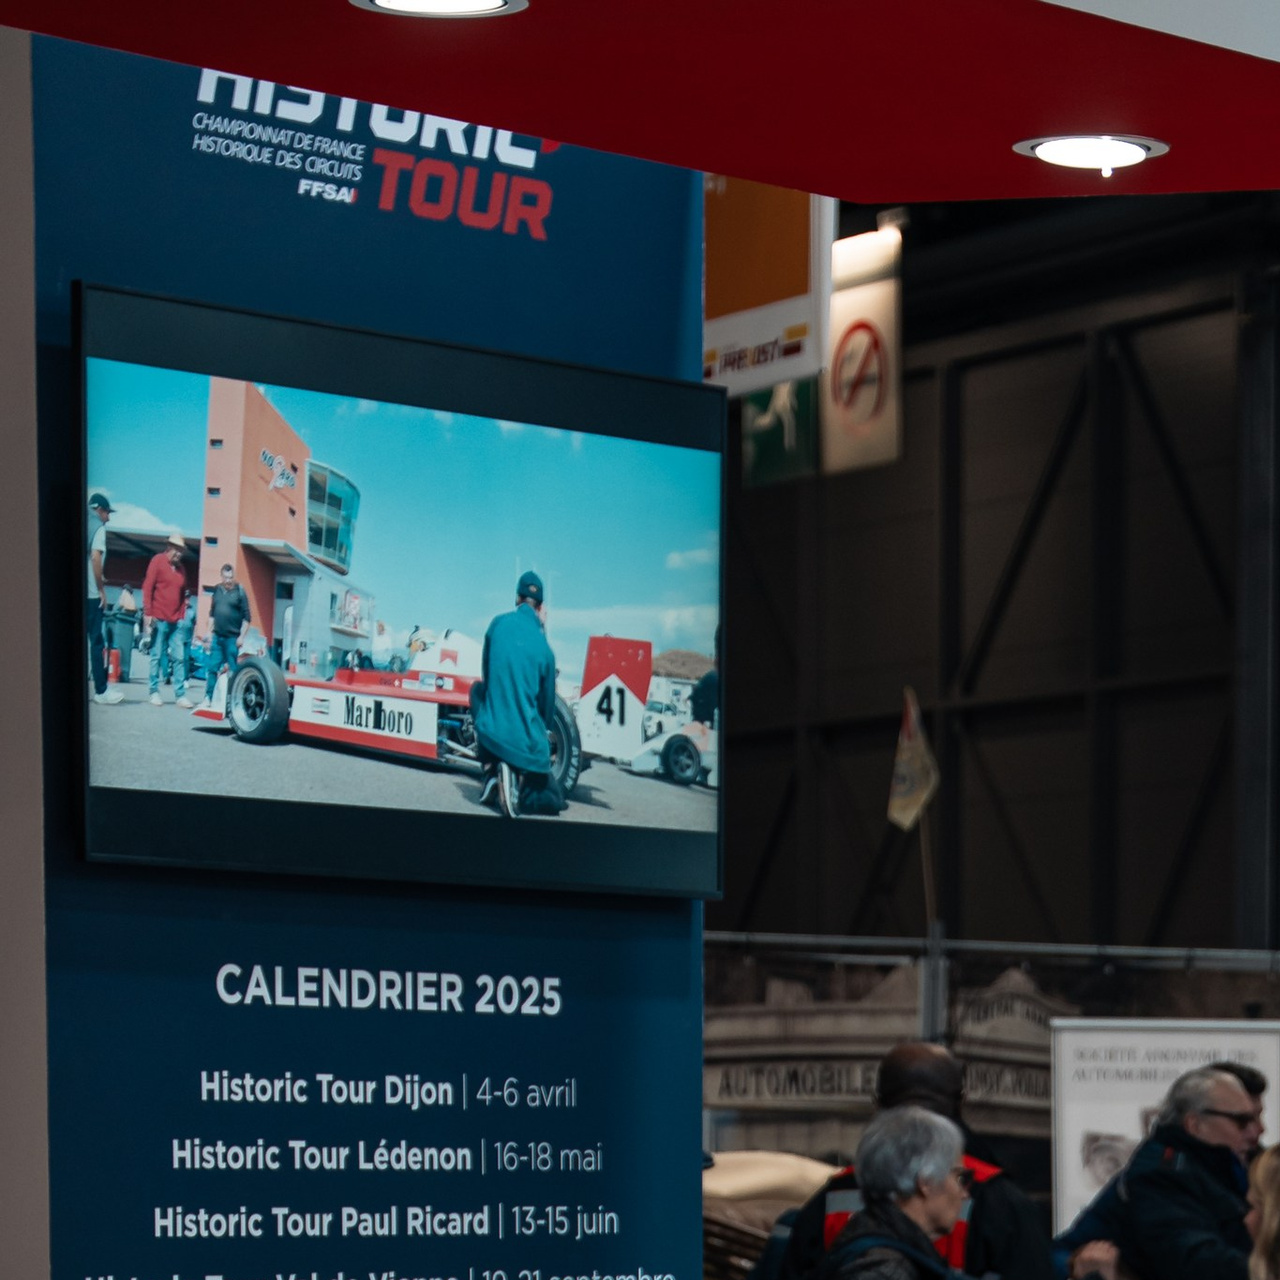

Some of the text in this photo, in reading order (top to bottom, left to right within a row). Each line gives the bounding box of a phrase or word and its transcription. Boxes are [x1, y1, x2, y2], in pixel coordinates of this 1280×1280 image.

[192, 112, 366, 161] CHAMPIONNAT DE FRANCE
[192, 134, 363, 181] HISTORIQUE DES CIRCUITS
[372, 147, 554, 241] TOUR
[597, 687, 627, 726] 41
[216, 963, 562, 1015] CALENDRIER 2025
[201, 1071, 577, 1110] Historic Tour Dijon 4-6 avril
[172, 1139, 603, 1172] Historic Tour Lédenon 16-18 mai
[154, 1205, 619, 1241] Historic Tour Paul Ricard 13-15 juin
